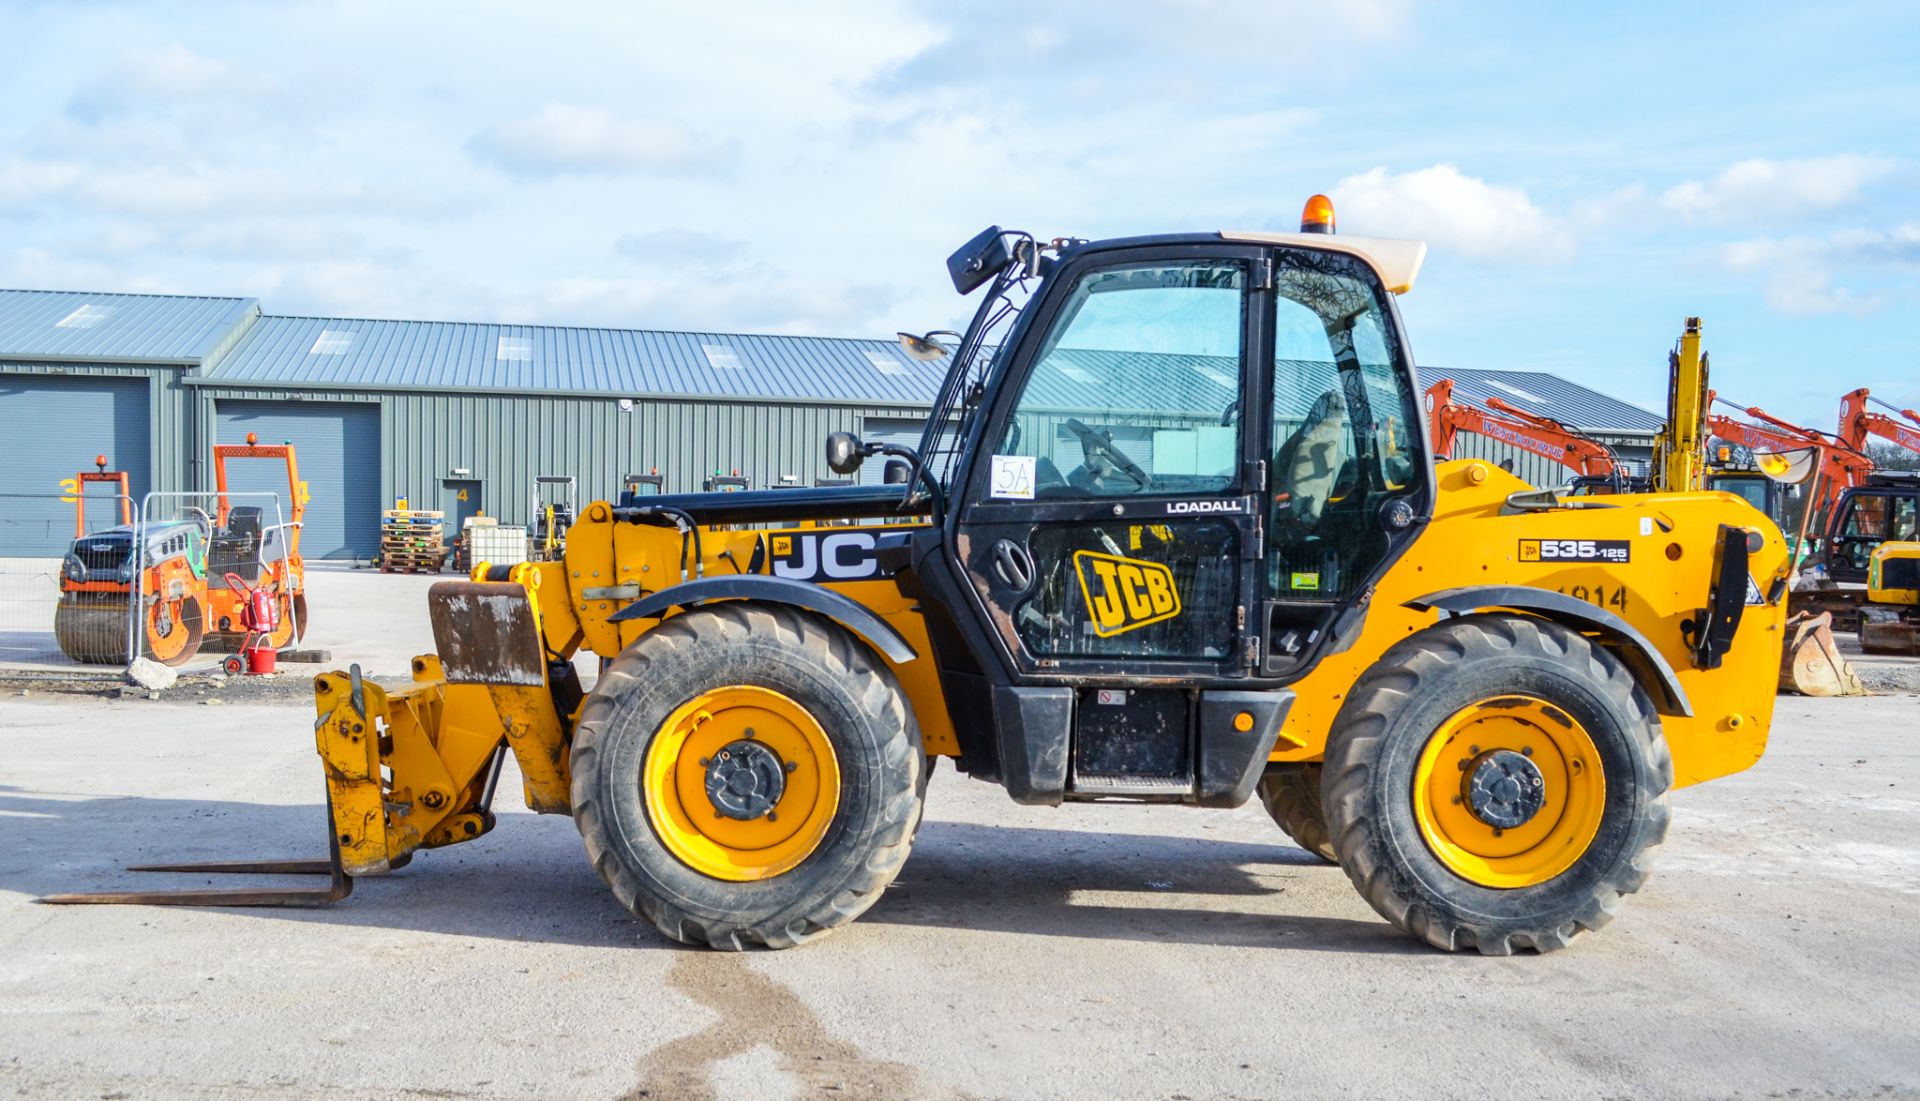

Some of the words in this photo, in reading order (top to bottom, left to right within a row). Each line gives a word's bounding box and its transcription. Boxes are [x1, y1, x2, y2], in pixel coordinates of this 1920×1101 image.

[1482, 417, 1565, 460] WESTBOURNE
[59, 478, 78, 503] 3
[996, 461, 1031, 491] 5A
[456, 488, 469, 502] 4
[1167, 501, 1242, 513] LOADALL
[773, 532, 914, 581] JC
[1092, 560, 1174, 627] JCB
